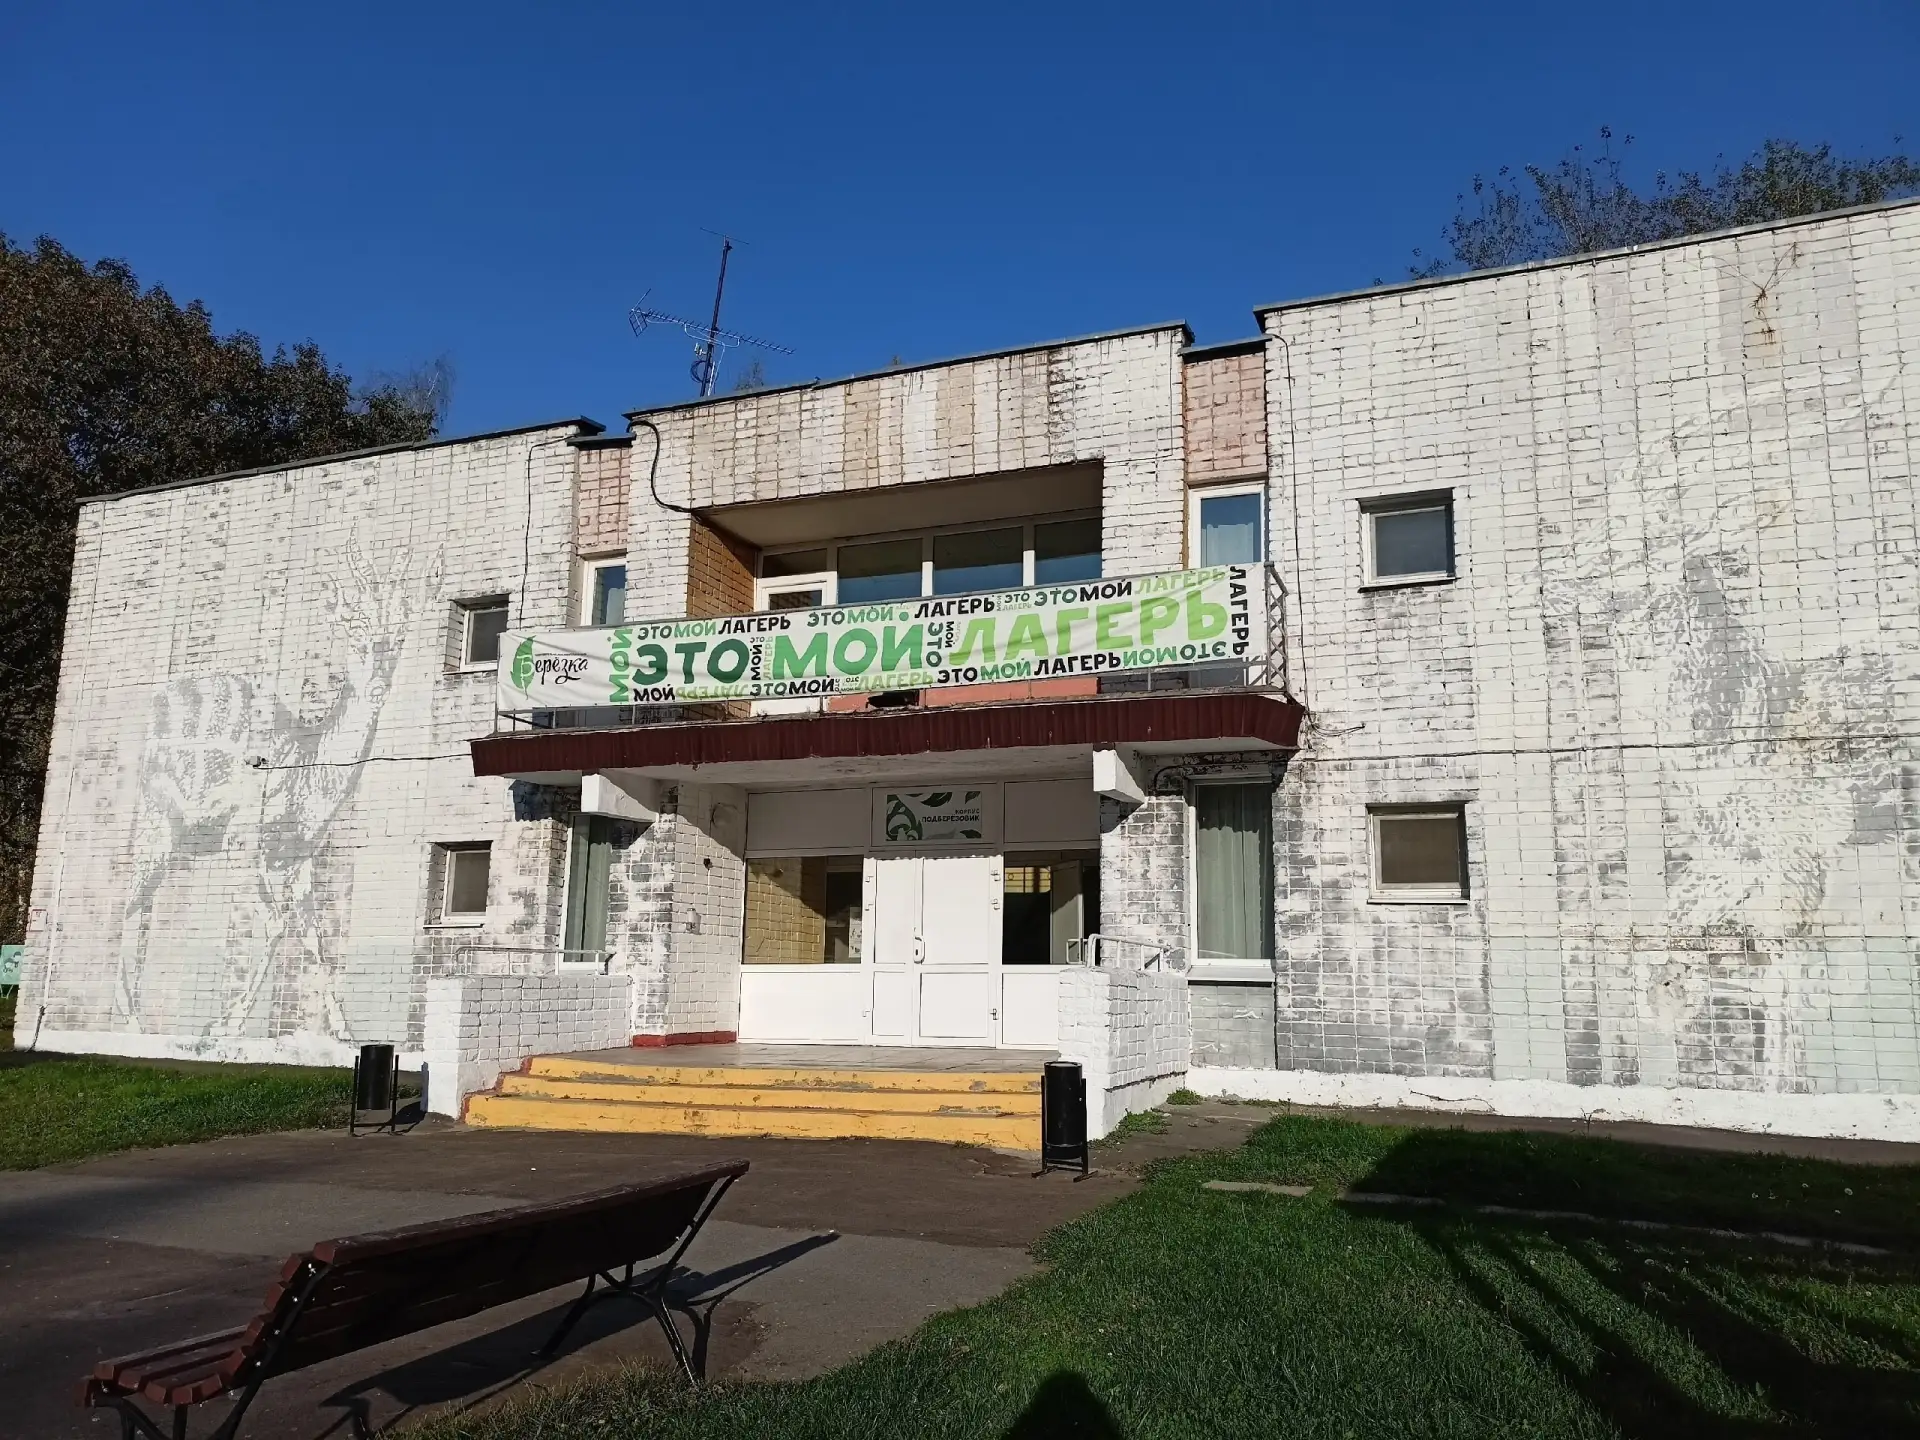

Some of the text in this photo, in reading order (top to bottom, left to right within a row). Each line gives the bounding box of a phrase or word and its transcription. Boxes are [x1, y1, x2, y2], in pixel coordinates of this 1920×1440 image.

[1004, 593, 1030, 603] ЭТО
[1034, 569, 1225, 606] ЭТО МОЙ ЛАГЕРЬ
[807, 611, 845, 627] ЭТО
[914, 596, 995, 618] ЛАГЕРЬ
[1229, 566, 1249, 655] ЛАГЕРЬ
[632, 638, 750, 686] ЭТО
[948, 590, 1228, 666] ЛАГЕРЬ
[637, 626, 672, 640] ЭТО
[718, 615, 791, 635] ЛАГЕРЬ
[945, 621, 955, 648] МОЙ
[926, 622, 943, 668] ЭТО
[516, 654, 589, 687] Берёзка
[750, 644, 762, 681] МОЙ
[937, 667, 978, 684] ЭТО
[980, 658, 1031, 681] МОЙ
[1034, 652, 1121, 676] ЛАГЕРЬ
[633, 684, 675, 702] МОЙ
[750, 675, 834, 697] ЭТО МОЙ
